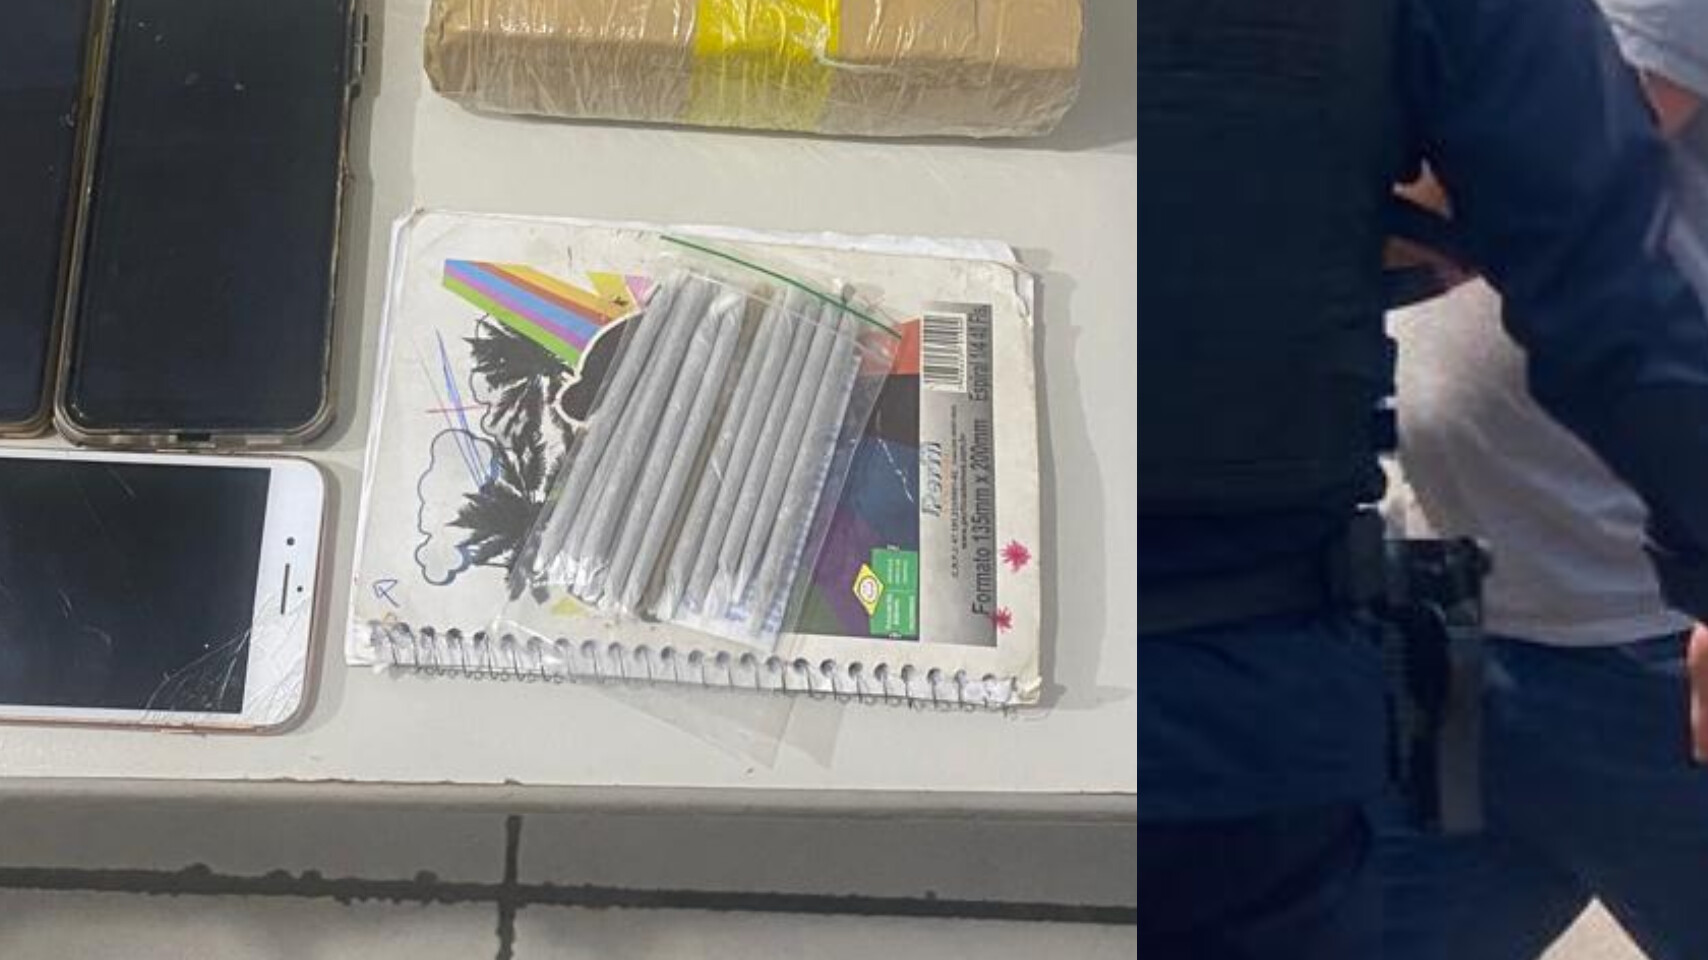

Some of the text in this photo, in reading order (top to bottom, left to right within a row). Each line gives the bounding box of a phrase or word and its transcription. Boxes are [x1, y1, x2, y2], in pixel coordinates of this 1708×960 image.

[968, 361, 990, 401] Espiral
[970, 419, 990, 470] 200mm
[971, 487, 991, 542] 135mm
[971, 547, 993, 616] Formato
